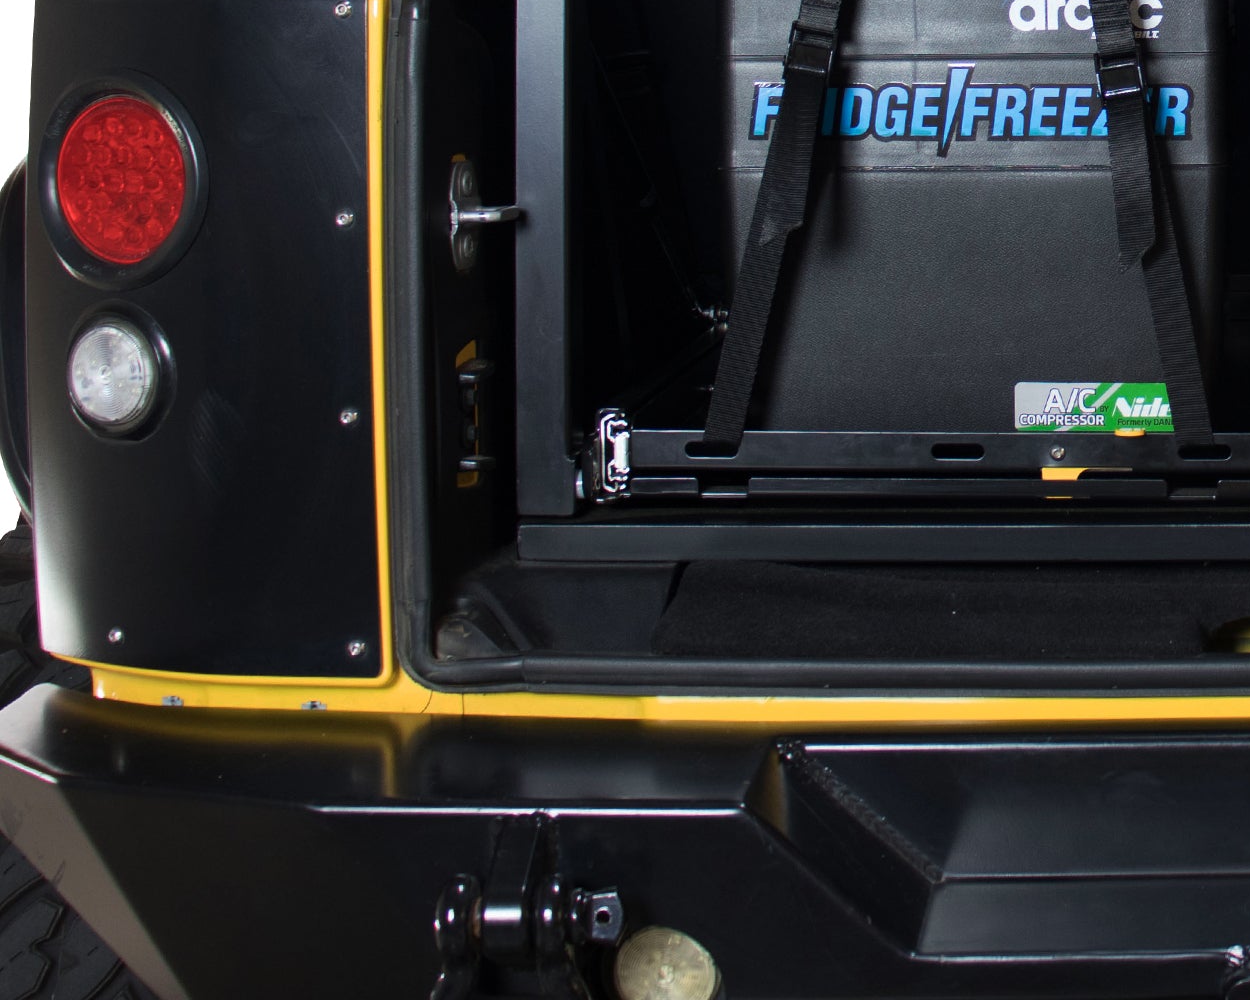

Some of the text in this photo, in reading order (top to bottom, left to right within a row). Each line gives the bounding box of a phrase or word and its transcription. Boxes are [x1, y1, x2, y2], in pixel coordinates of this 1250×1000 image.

[1043, 387, 1109, 413] A/C BY
[1112, 396, 1172, 418] Nide
[1019, 413, 1105, 426] COMPRESSOR
[1117, 418, 1174, 427] Formerly DAN
